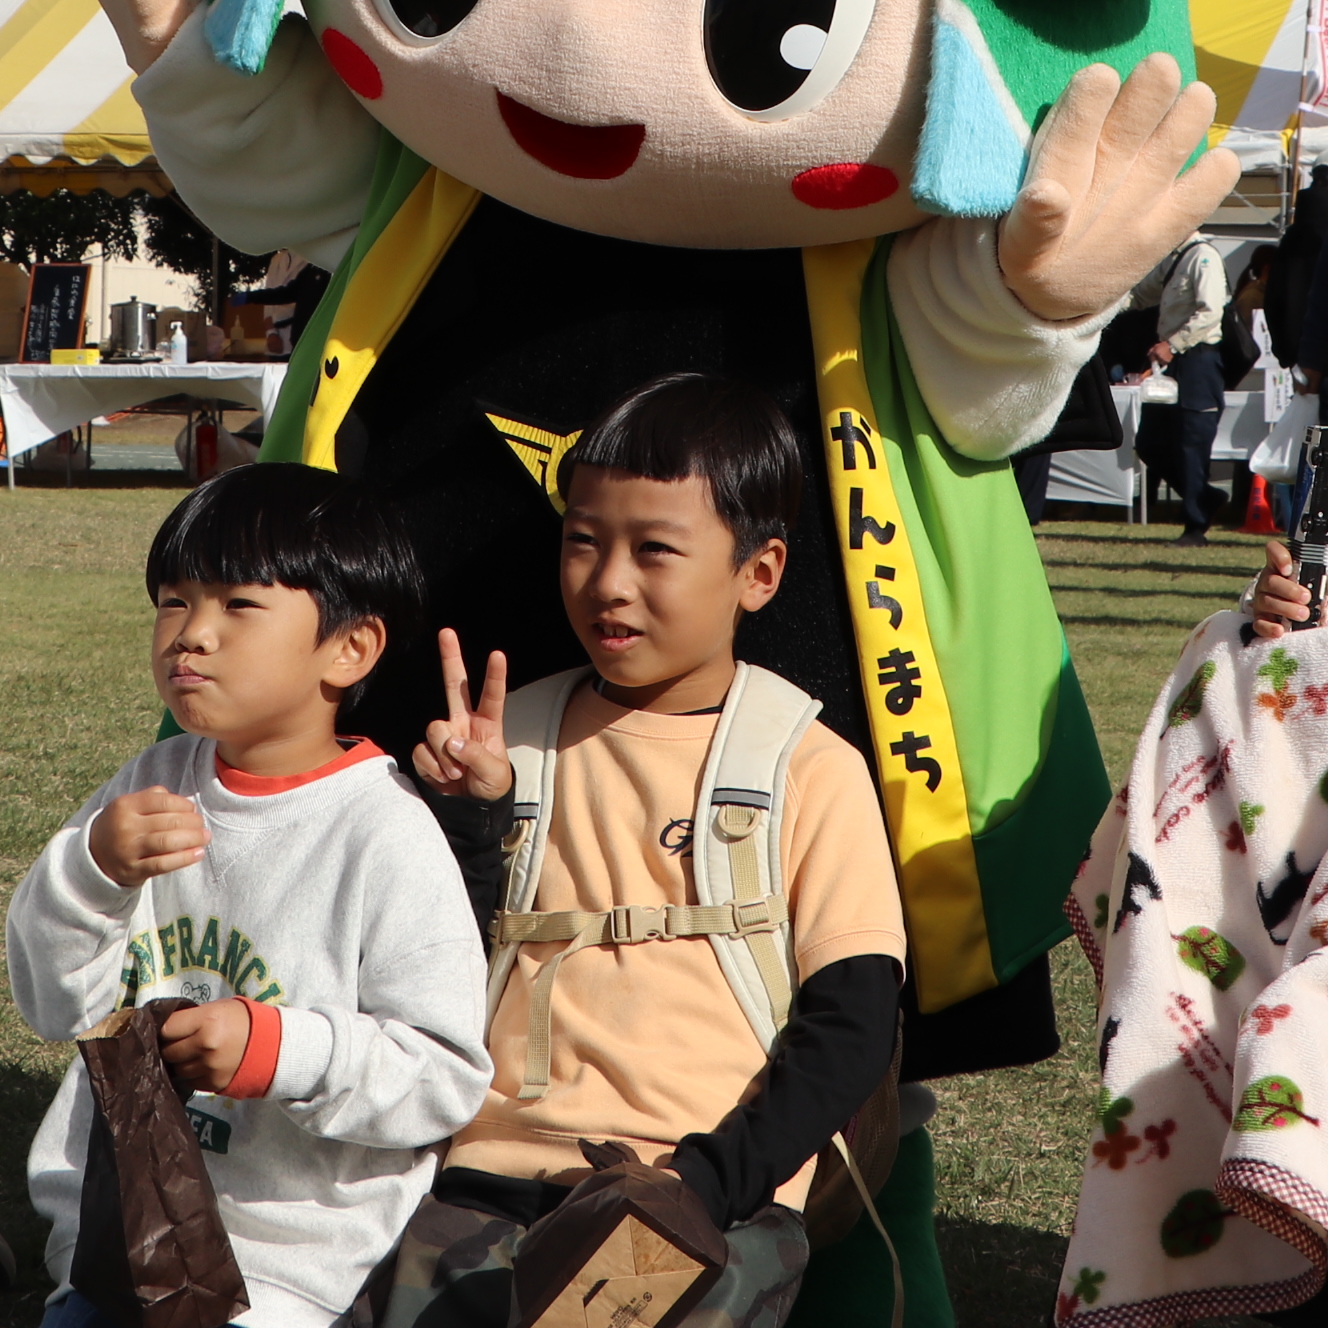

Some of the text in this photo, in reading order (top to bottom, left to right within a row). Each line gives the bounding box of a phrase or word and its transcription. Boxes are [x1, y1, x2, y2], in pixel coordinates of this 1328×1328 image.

[830, 412, 942, 793] かんらまち
